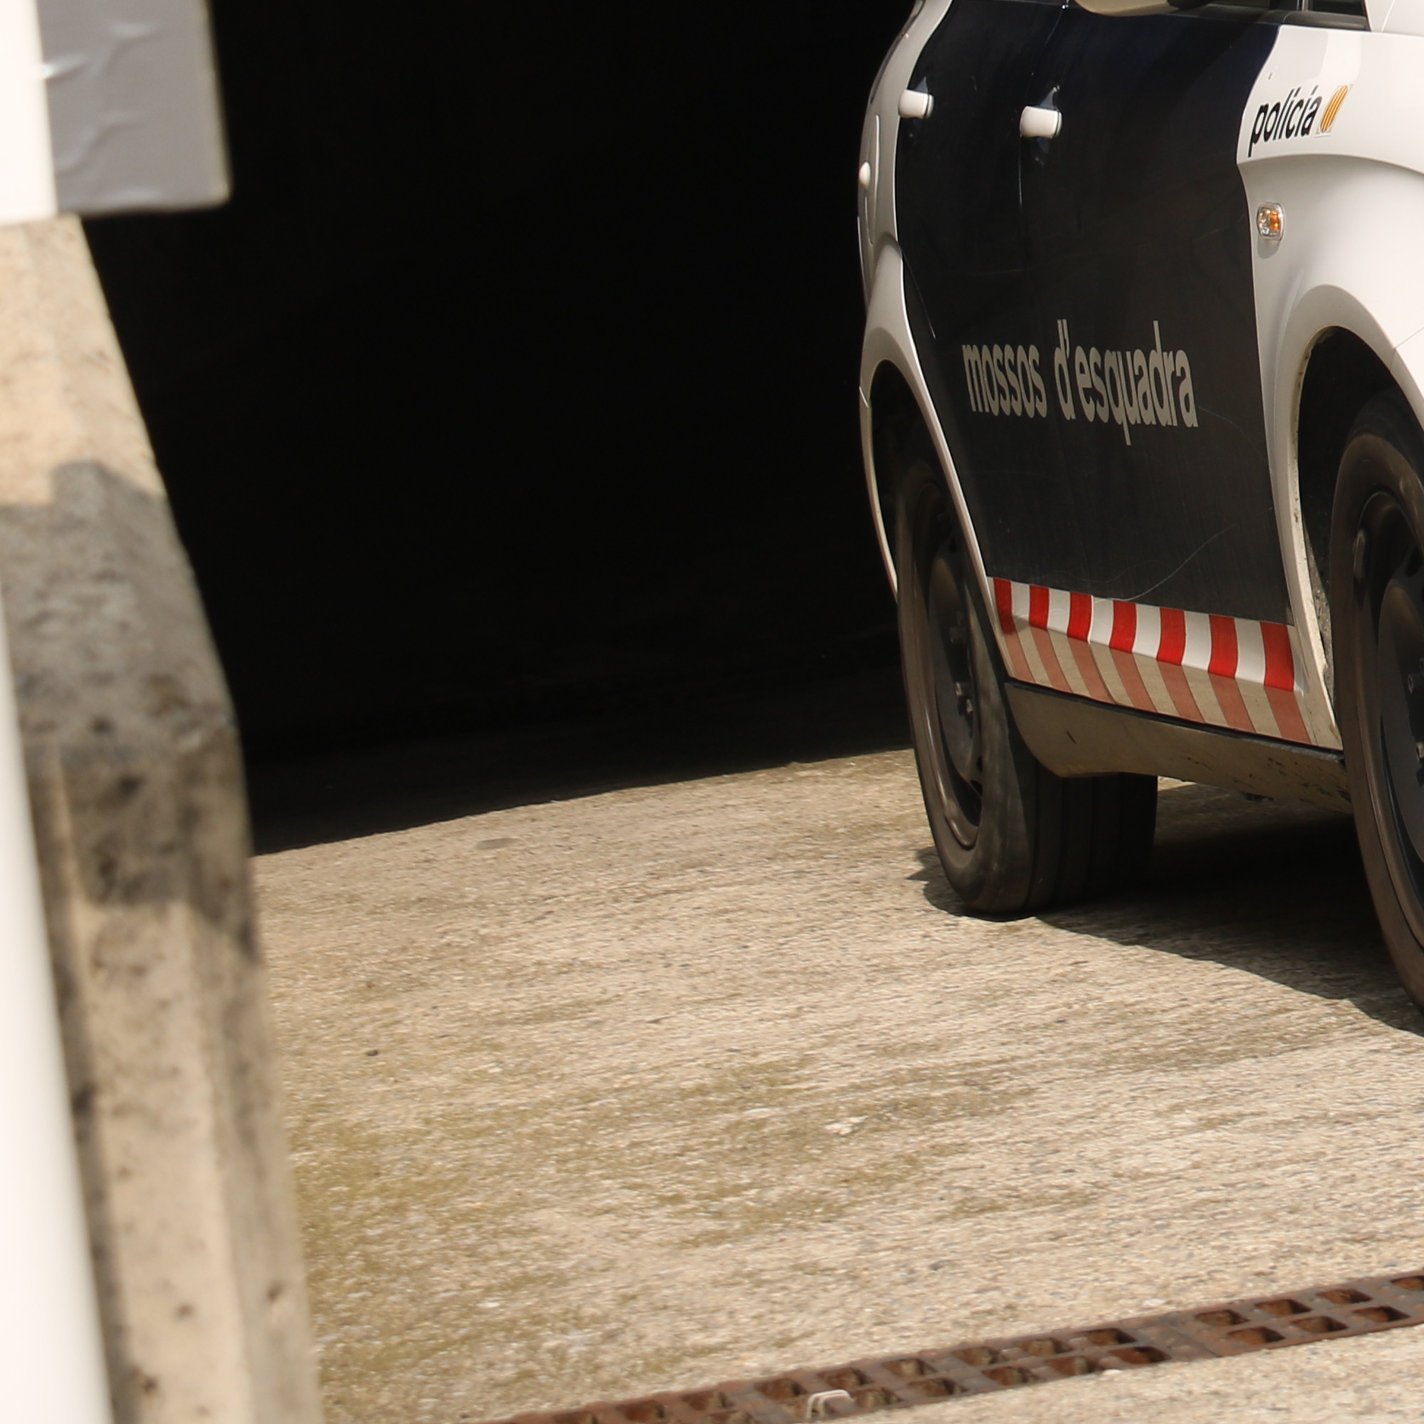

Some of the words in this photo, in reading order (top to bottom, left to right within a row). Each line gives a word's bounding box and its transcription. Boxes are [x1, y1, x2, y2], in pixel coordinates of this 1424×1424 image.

[1248, 85, 1322, 157] policia
[962, 344, 1048, 419] mossos
[1054, 319, 1199, 446] d'esquadra
